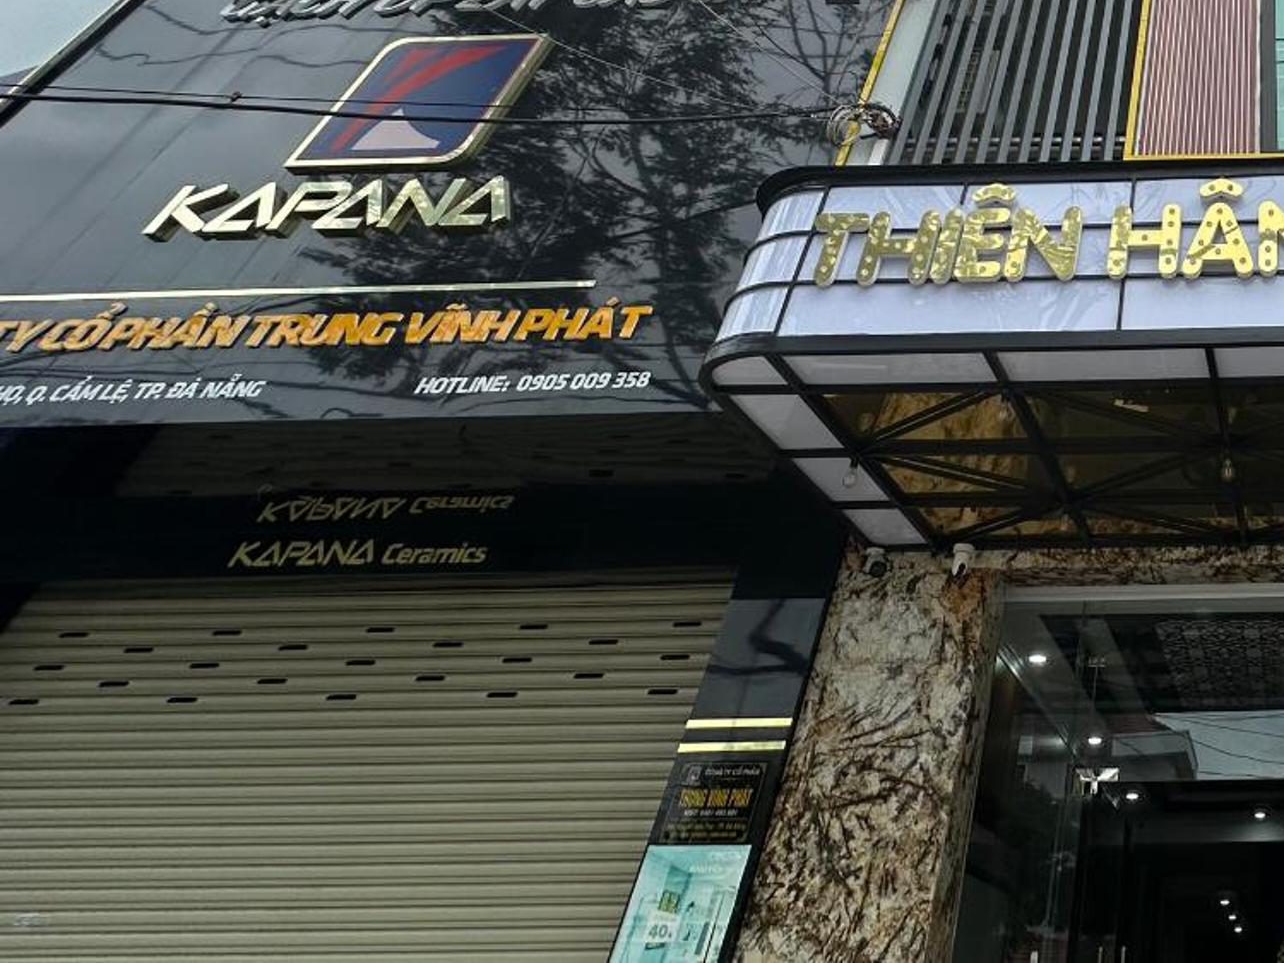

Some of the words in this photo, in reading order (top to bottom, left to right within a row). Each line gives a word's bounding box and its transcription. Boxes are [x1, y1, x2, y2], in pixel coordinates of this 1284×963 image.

[141, 175, 512, 241] KAPANA
[815, 183, 1083, 287] THIÊN
[245, 312, 403, 348] TRUNG
[405, 303, 521, 344] VĨNH
[513, 297, 653, 341] PHÁT
[134, 382, 166, 399] TP.
[414, 376, 511, 395] HOTLINE:
[516, 374, 570, 392] 0905
[570, 373, 611, 391] 009
[612, 372, 651, 389] 358
[227, 538, 375, 568] KAPANA
[381, 542, 488, 565] Ceramics
